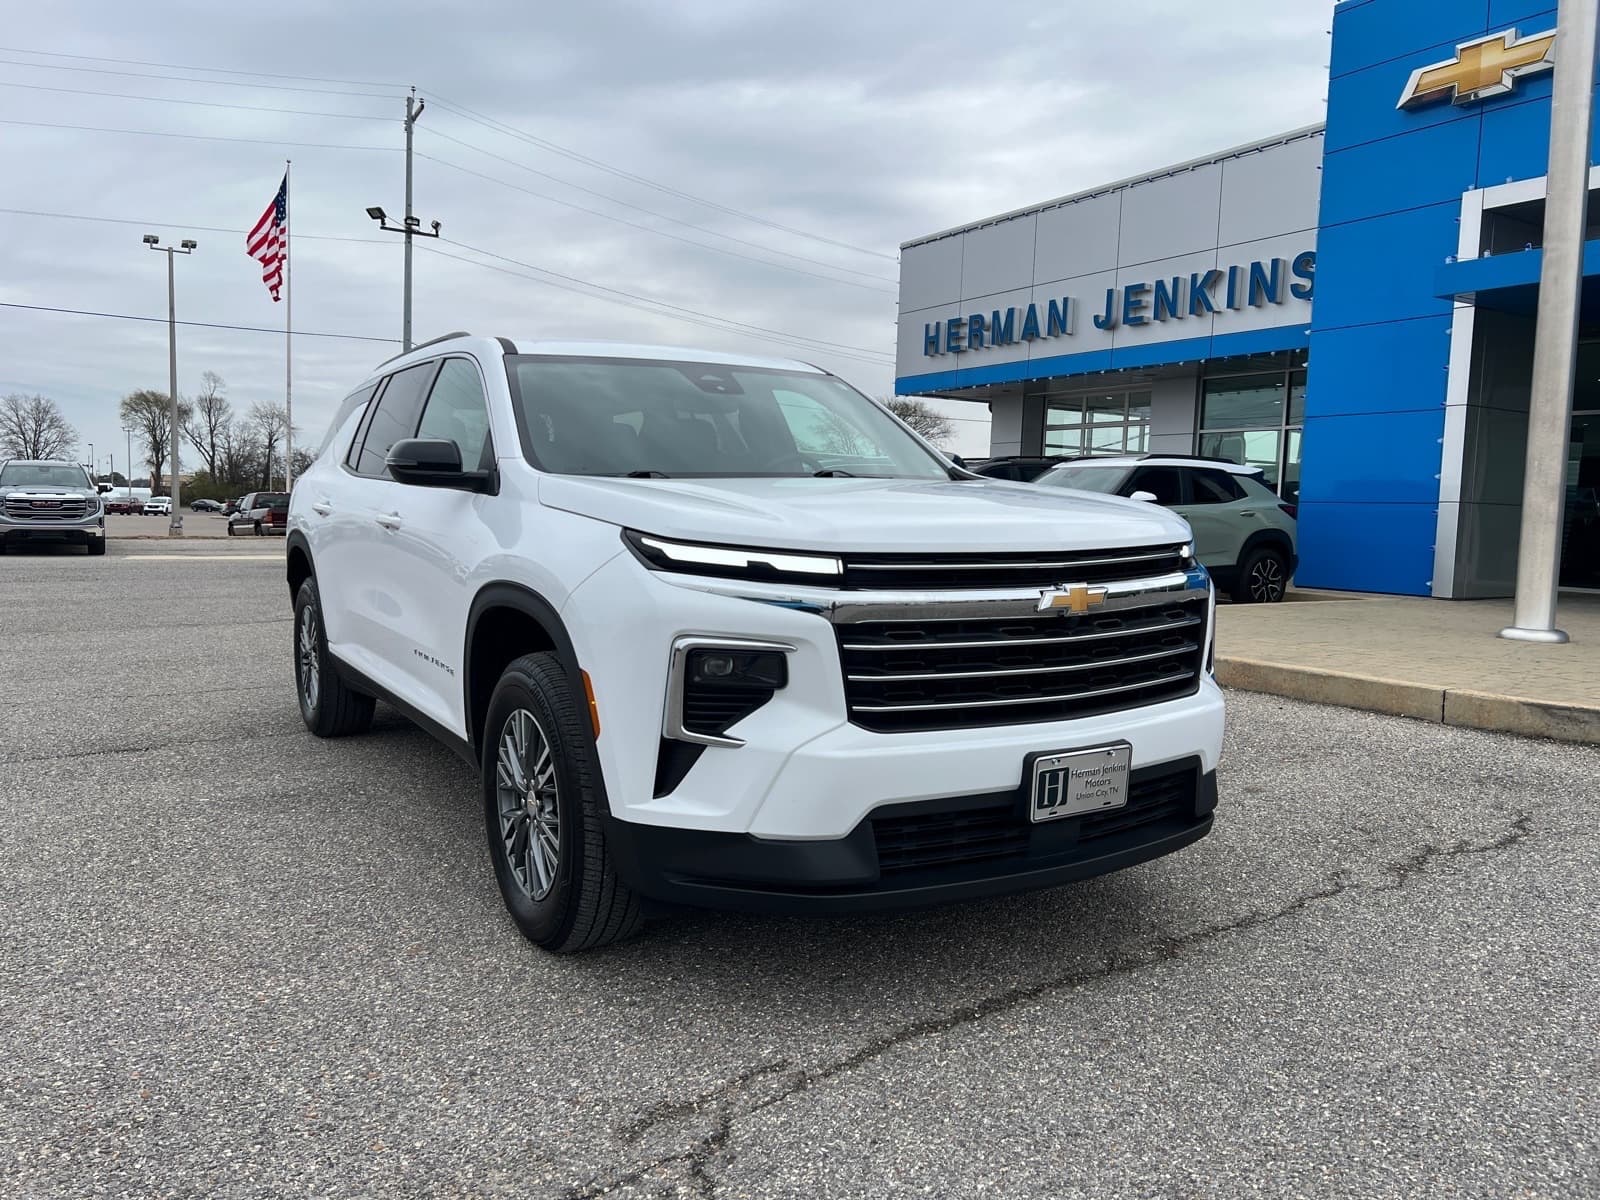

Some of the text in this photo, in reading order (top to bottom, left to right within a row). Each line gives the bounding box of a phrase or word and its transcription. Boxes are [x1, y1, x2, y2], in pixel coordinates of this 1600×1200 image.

[924, 251, 1316, 357] HERMAN JENKINS
[1071, 763, 1126, 778] Herman Jenkins
[1085, 778, 1112, 788] Motors
